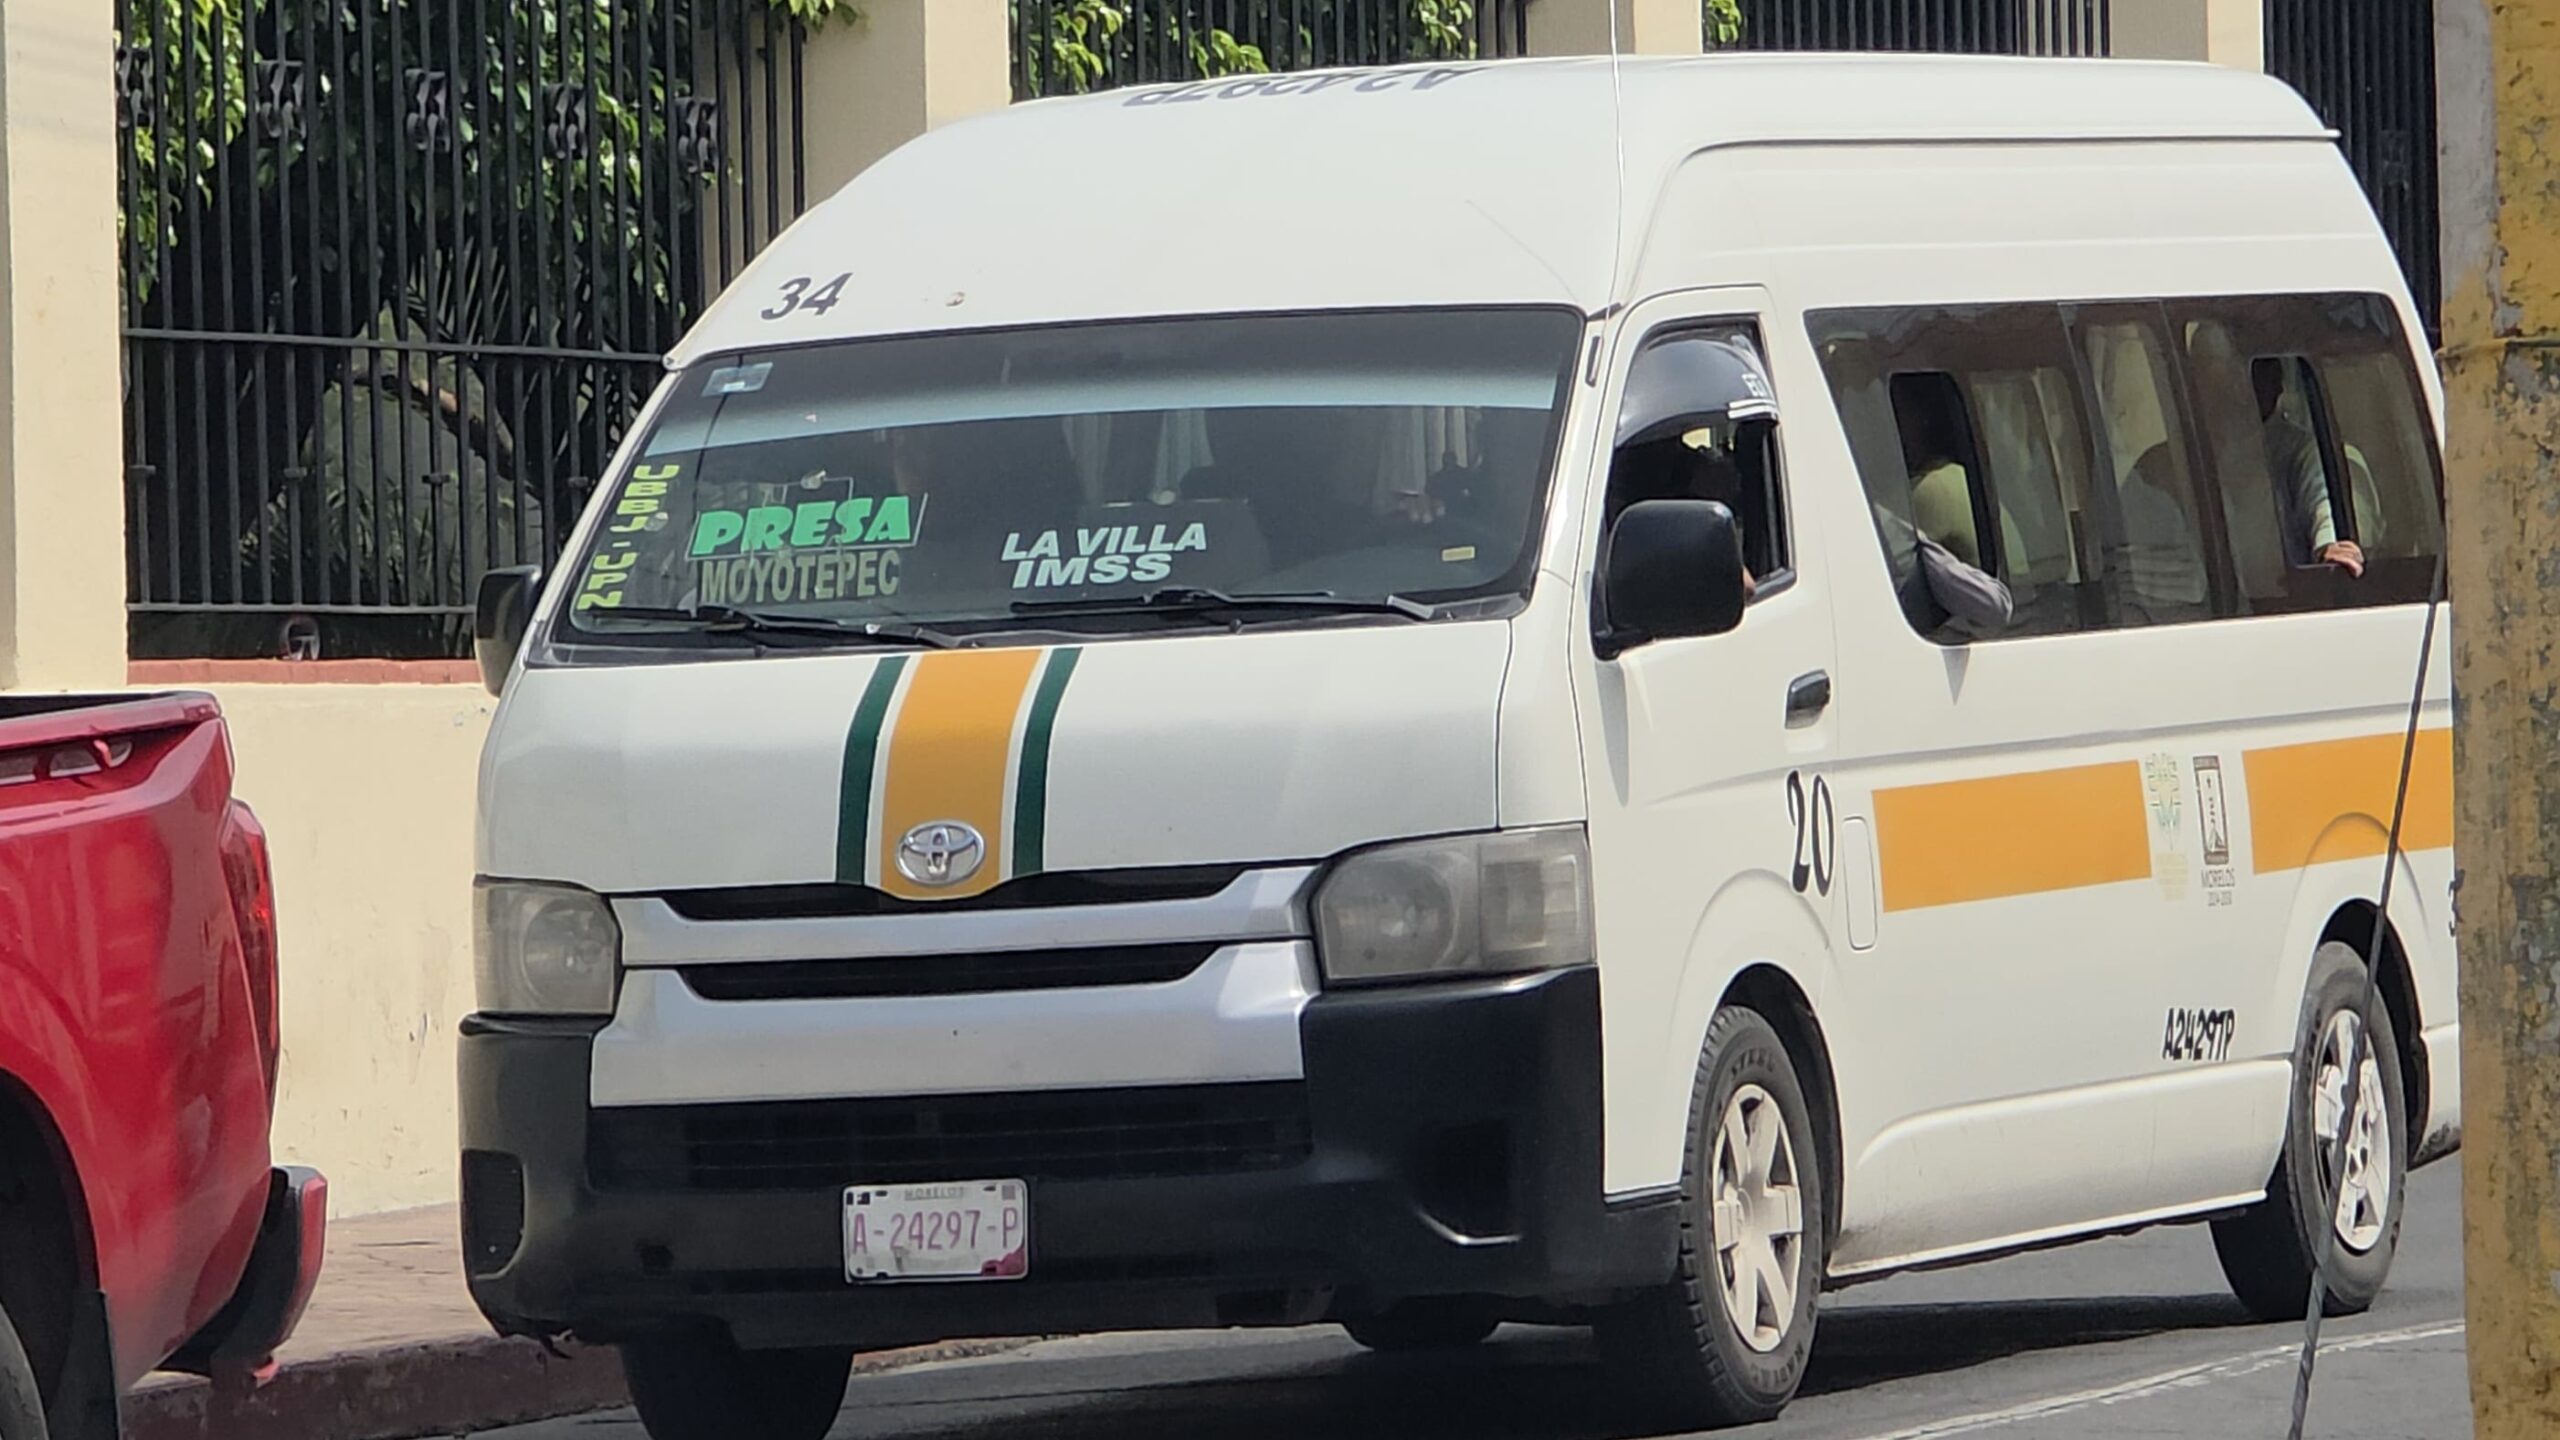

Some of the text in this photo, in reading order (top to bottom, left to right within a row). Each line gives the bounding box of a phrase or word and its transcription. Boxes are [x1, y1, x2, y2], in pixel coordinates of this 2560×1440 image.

[761, 273, 853, 320] 34
[692, 496, 911, 555] PRESA
[1001, 522, 1207, 561] LA VILLA
[701, 550, 900, 602] MOYOTEPEC
[1012, 552, 1172, 589] IMSS
[1786, 769, 1834, 897] 20
[2162, 1007, 2235, 1061] A24297P
[852, 1207, 1018, 1254] A-24297-P
